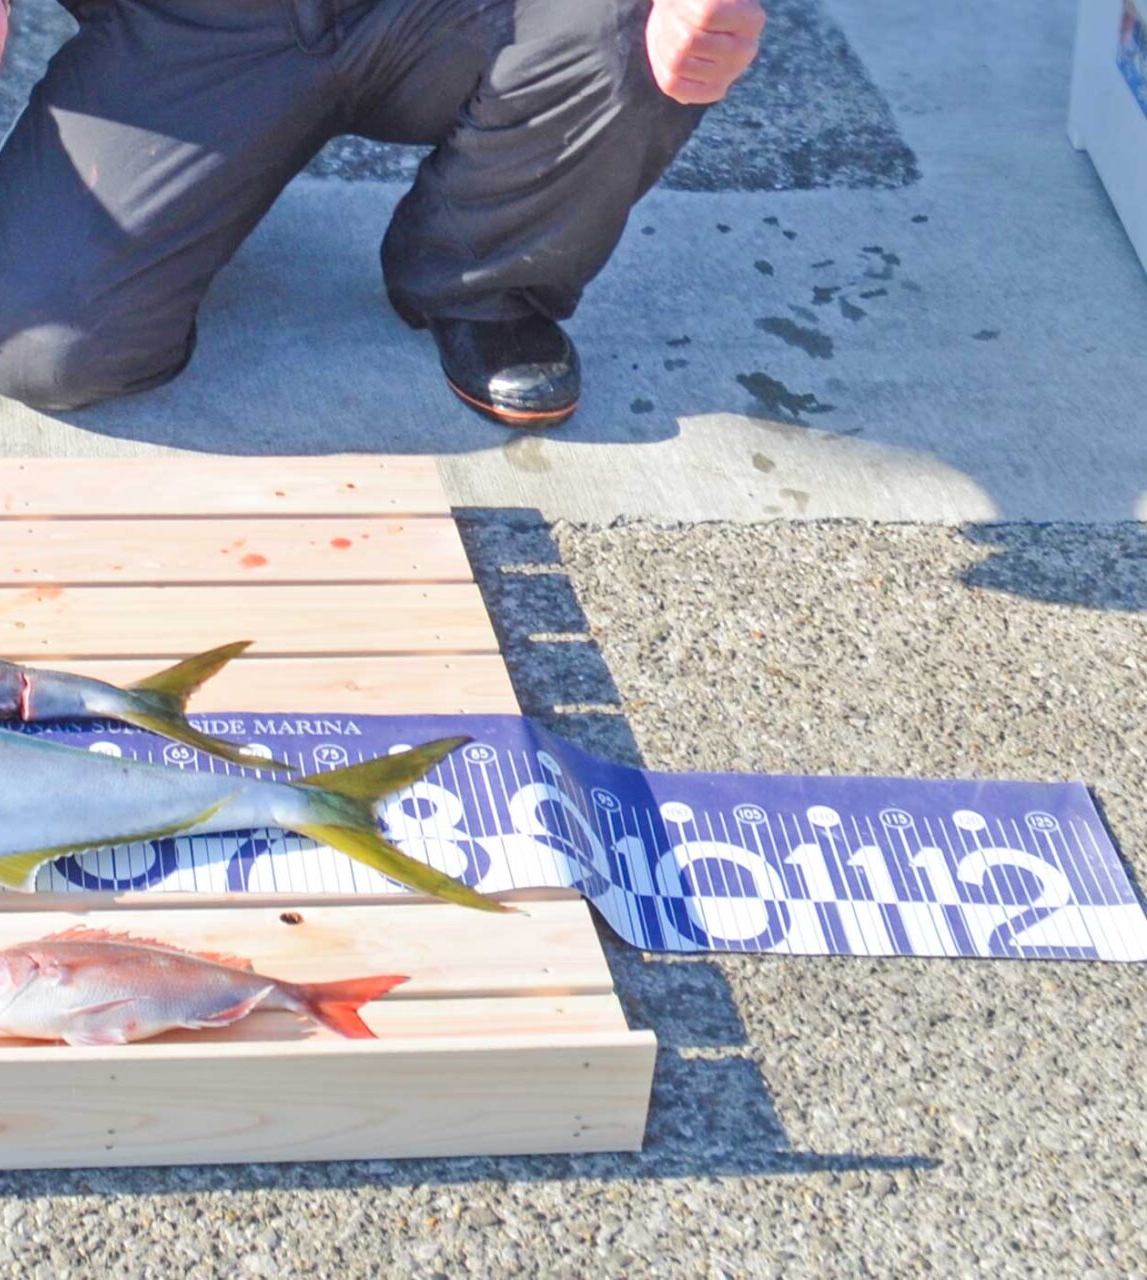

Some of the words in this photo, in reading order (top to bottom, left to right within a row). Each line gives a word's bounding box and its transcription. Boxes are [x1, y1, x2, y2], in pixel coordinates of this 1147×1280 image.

[254, 719, 362, 735] MARINA
[171, 747, 189, 759] 65
[320, 748, 340, 760] 75
[470, 747, 489, 760] 85
[738, 809, 762, 820] 105
[884, 813, 909, 825] 115
[1030, 816, 1053, 828] 125
